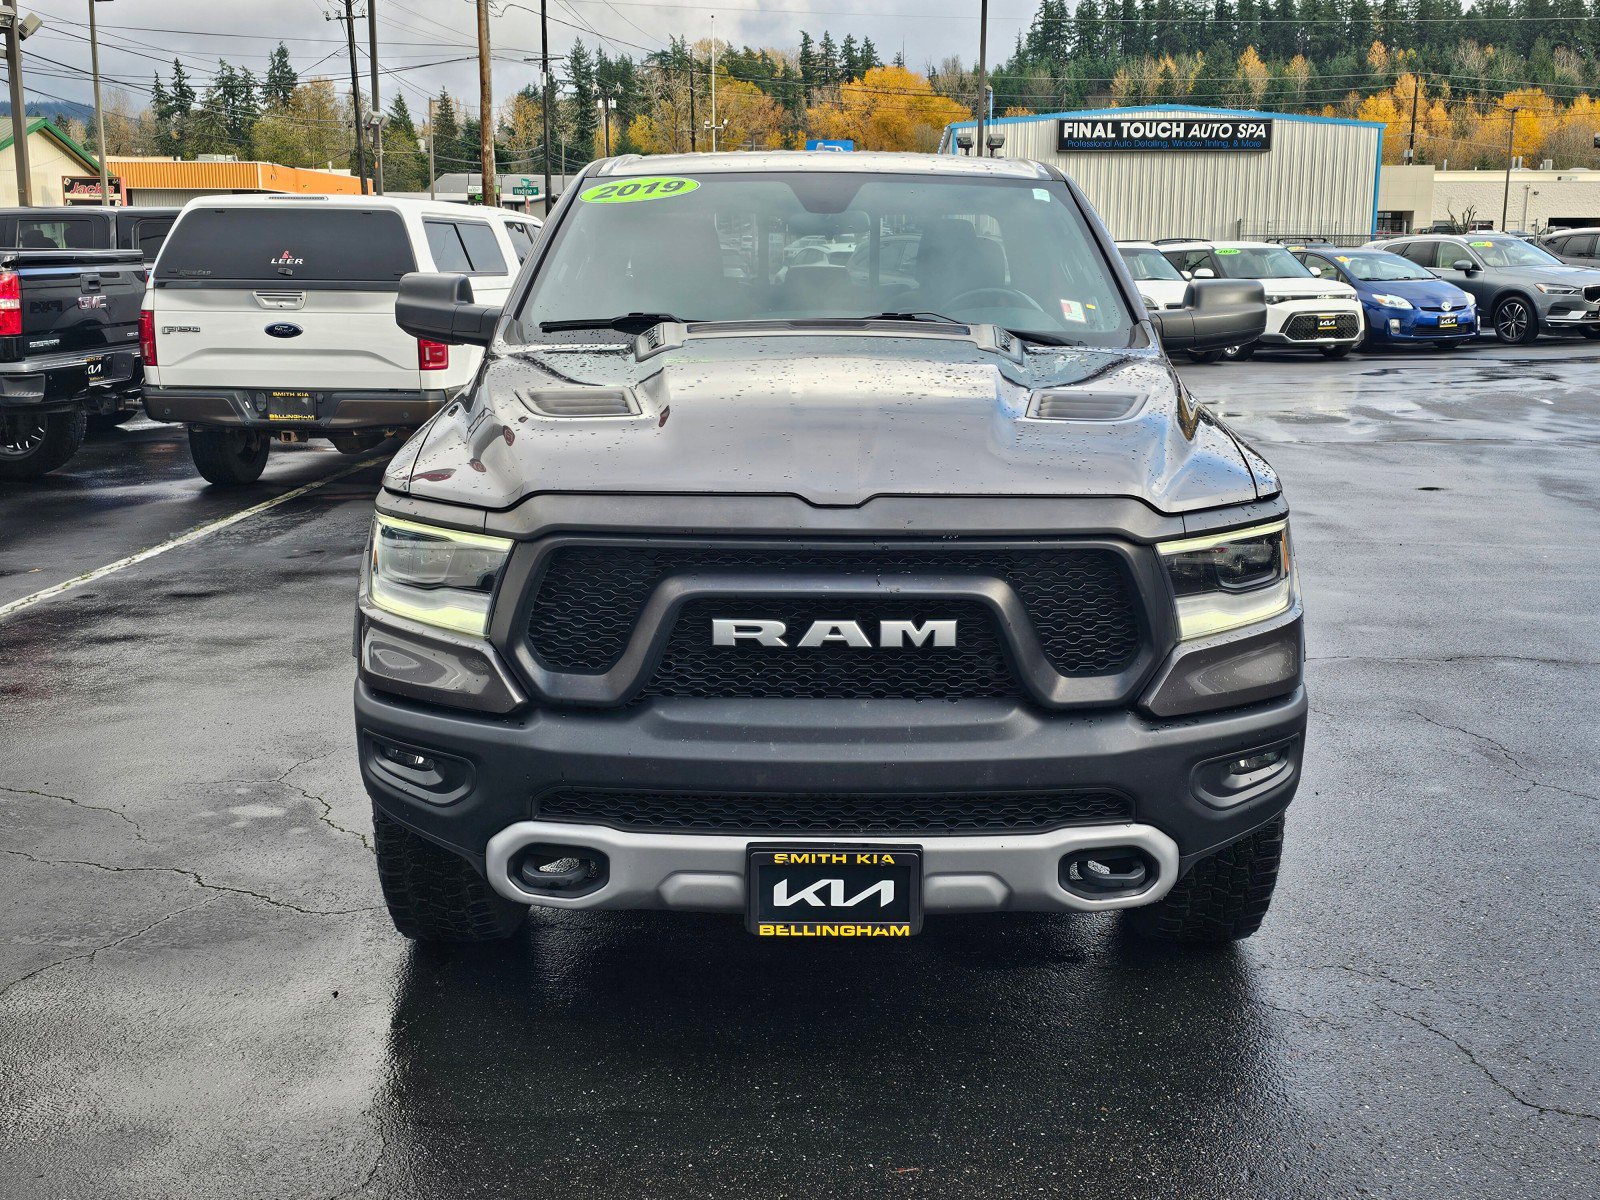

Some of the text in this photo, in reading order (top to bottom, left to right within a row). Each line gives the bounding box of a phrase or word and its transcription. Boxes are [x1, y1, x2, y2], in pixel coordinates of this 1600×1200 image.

[1063, 121, 1267, 138] FINAL TOUCH AUTO SPA
[1067, 139, 1112, 148] Professional
[1134, 139, 1170, 149] Detailing,
[1172, 139, 1202, 147] Window
[591, 180, 686, 200] 2019
[78, 295, 107, 309] GMC
[712, 619, 958, 648] RAM
[774, 853, 895, 865] SMITH KIA
[773, 878, 895, 907] KIA
[759, 925, 910, 937] BELLINGHAM
